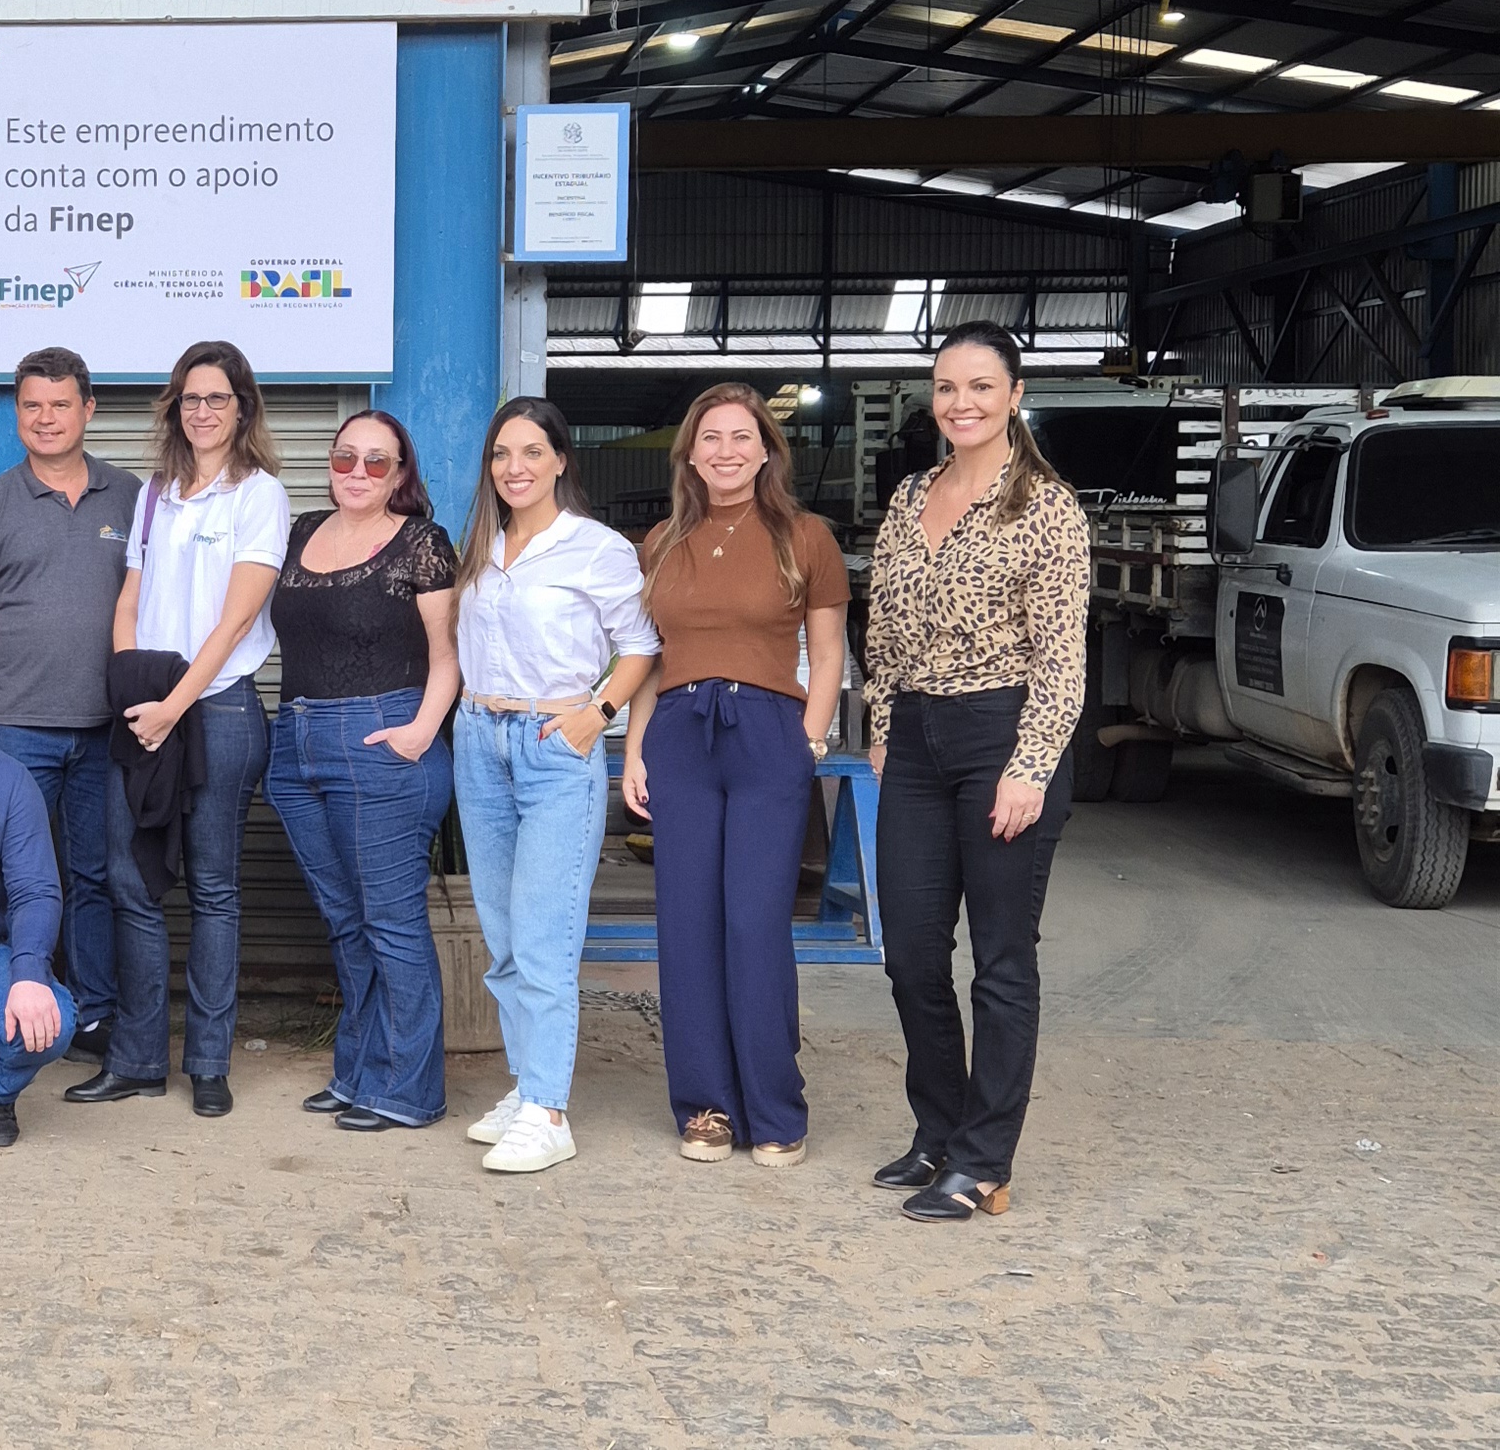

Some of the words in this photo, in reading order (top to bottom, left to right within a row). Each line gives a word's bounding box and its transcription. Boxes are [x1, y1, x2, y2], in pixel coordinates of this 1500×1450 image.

[6, 118, 66, 145] Este
[75, 115, 334, 150] empreendimento
[4, 163, 86, 188] conta
[97, 164, 158, 188] com
[168, 164, 186, 187] o
[196, 161, 279, 194] apoio
[4, 205, 38, 233] da
[50, 206, 134, 240] Finep
[250, 258, 297, 266] GOVERNO
[300, 258, 344, 266] FEDERAL
[149, 269, 208, 277] MINISTÉRIO
[211, 269, 224, 277] DA
[113, 280, 158, 289] CIÊNCIA,
[160, 280, 224, 288] TECNOLOGIA
[240, 270, 352, 298] BRASIL
[173, 289, 224, 299] INOVAÇÃO
[250, 301, 273, 309] UNIÃO
